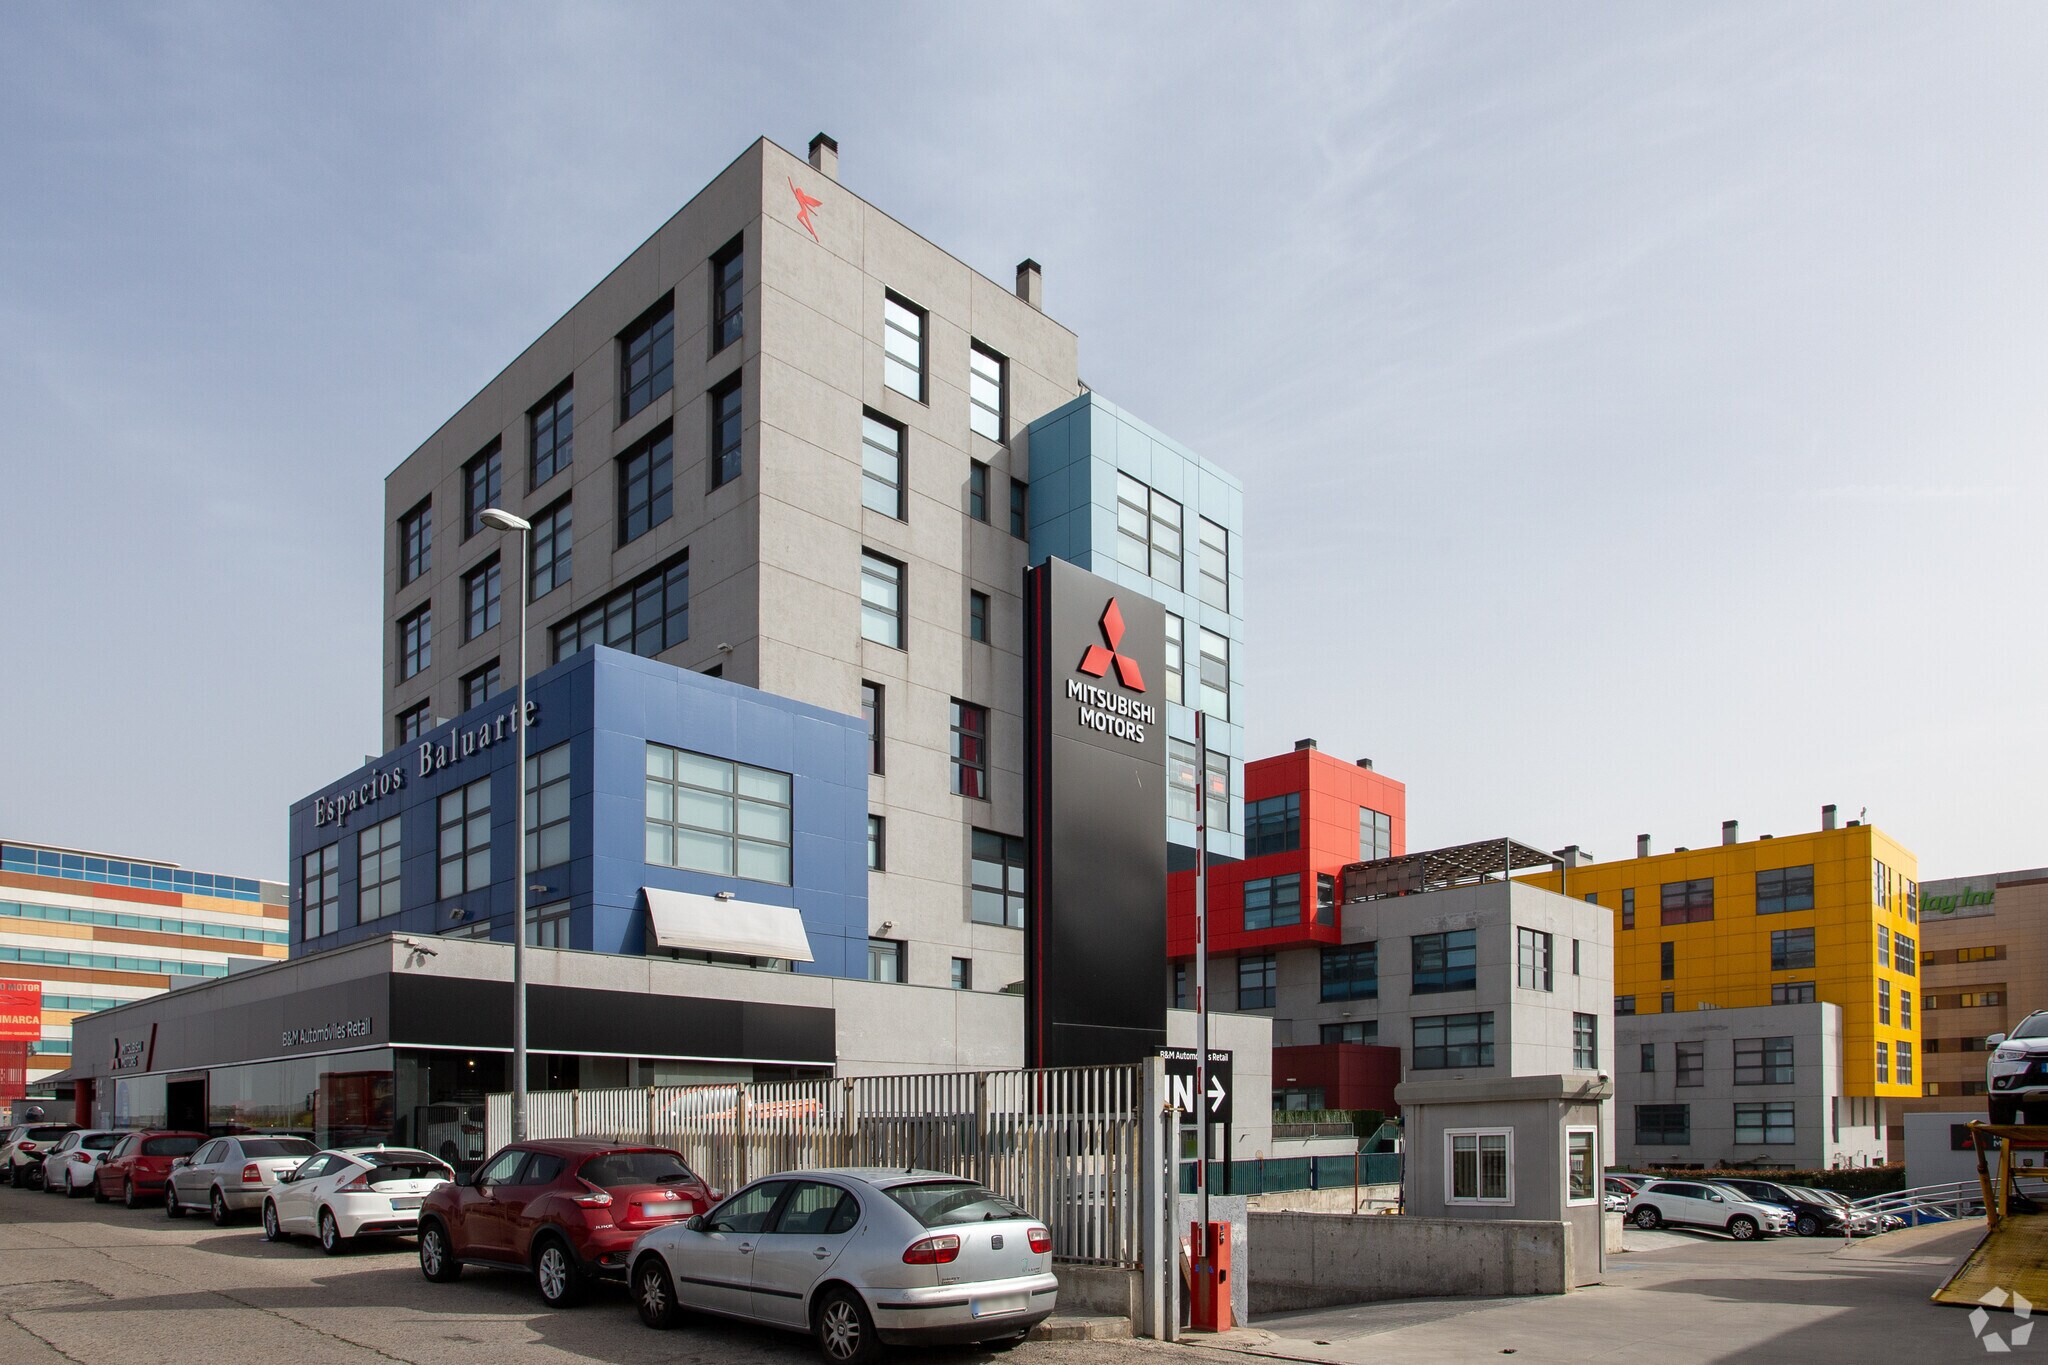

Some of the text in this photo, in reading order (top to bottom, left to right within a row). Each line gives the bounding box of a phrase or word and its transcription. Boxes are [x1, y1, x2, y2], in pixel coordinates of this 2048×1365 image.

[1066, 678, 1156, 726] MITSUBISHI
[1079, 706, 1145, 744] MOTORS
[314, 699, 537, 827] Espacios Baluarte
[8, 983, 40, 992] MOTOR
[282, 1016, 372, 1047] B&M Automóviles Retail
[1160, 1050, 1175, 1060] B&M
[1212, 1052, 1229, 1062] Retail
[1164, 1074, 1194, 1113] IN
